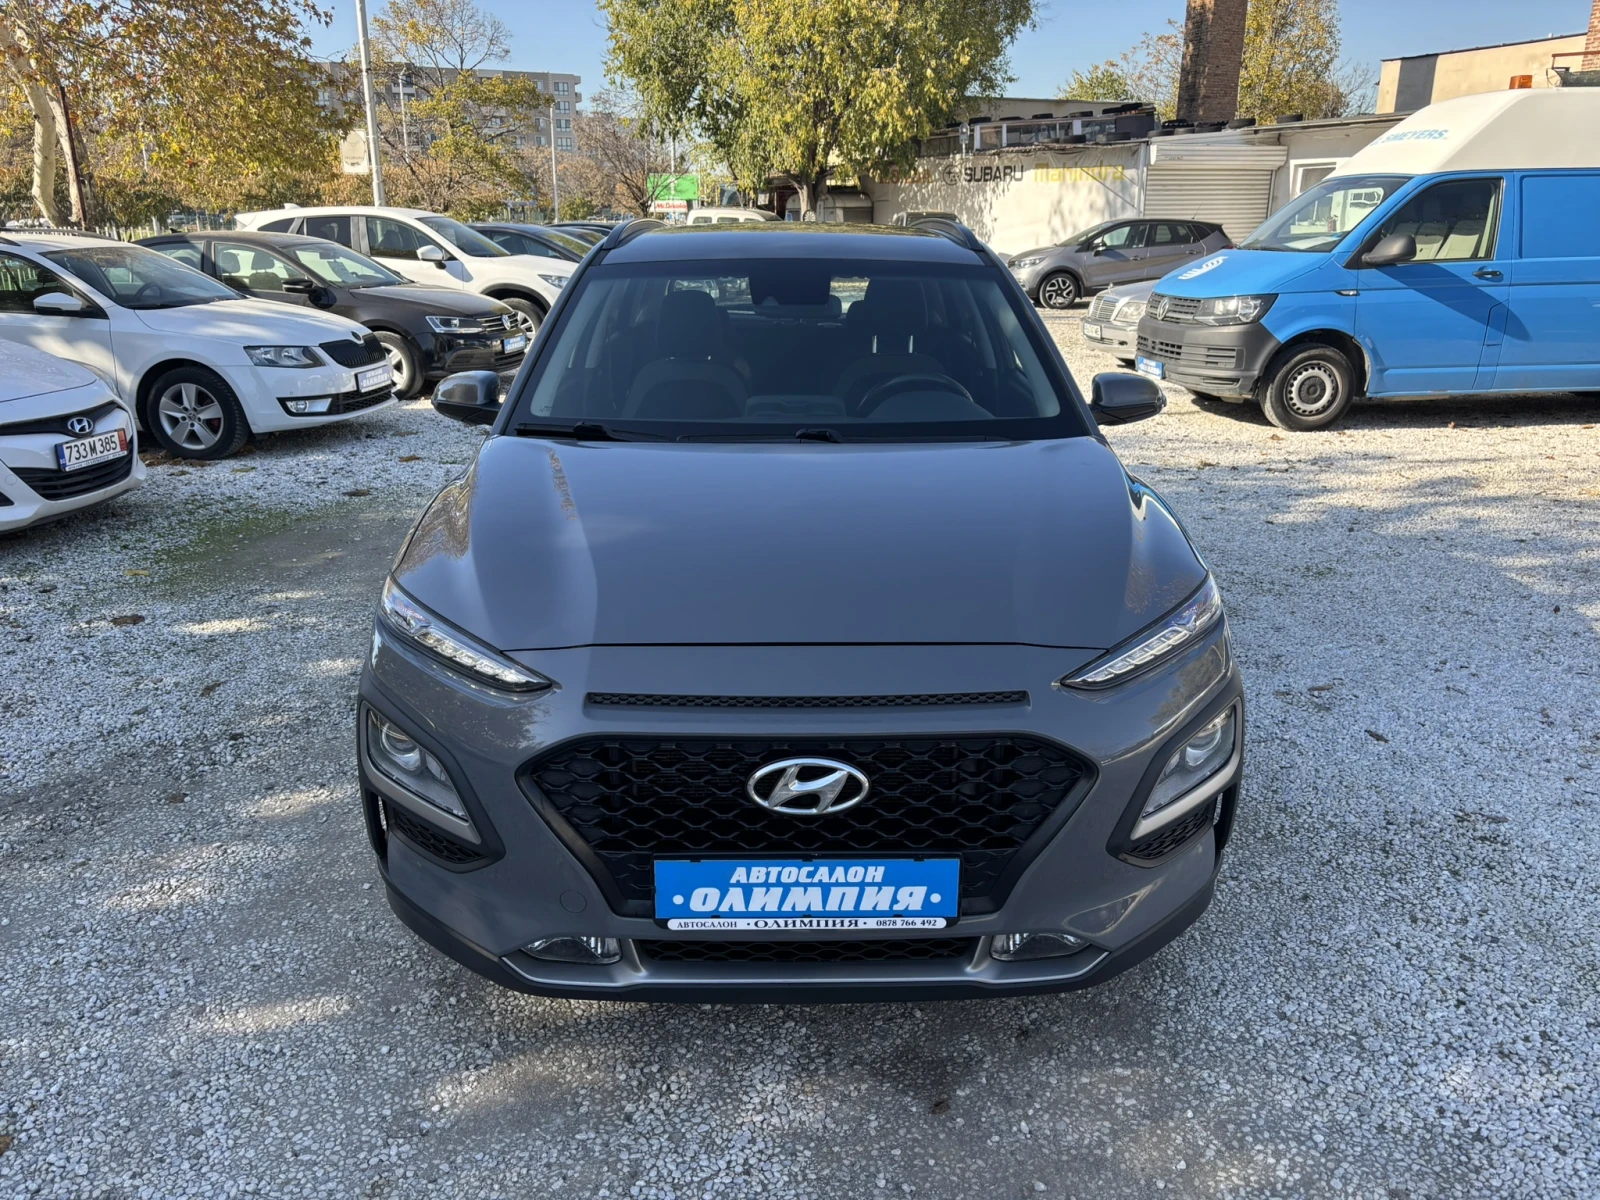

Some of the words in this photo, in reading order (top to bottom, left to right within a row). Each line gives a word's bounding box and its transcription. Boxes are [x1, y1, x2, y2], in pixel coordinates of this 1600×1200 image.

[964, 165, 1024, 183] SUBARU
[65, 443, 87, 463] 733
[88, 439, 98, 457] M
[99, 434, 118, 454] 385
[729, 865, 885, 884] АВТОСАЛОН
[689, 886, 927, 912] ОЛИМПИЯ
[754, 919, 859, 928] ОЛИМПИЯ
[876, 919, 897, 927] 0878
[900, 919, 917, 927] 766
[920, 919, 937, 927] 492
